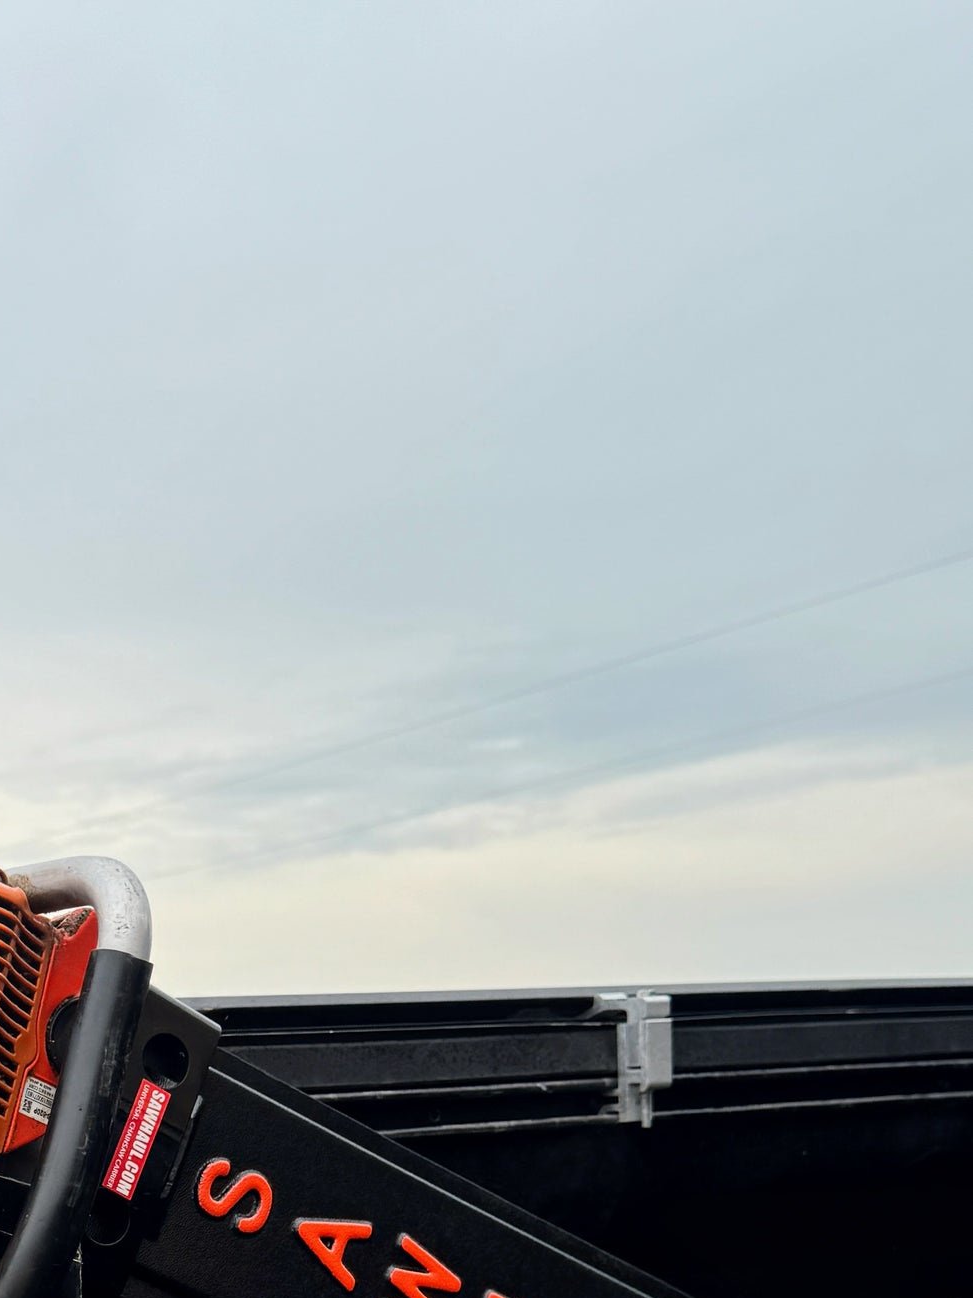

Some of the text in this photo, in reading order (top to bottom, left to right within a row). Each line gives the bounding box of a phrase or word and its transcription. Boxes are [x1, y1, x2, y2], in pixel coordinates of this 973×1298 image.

[107, 1085, 150, 1188] UNIVERSAL CHAINSAW CARRIER
[116, 1090, 165, 1196] SAWHAUL.COM
